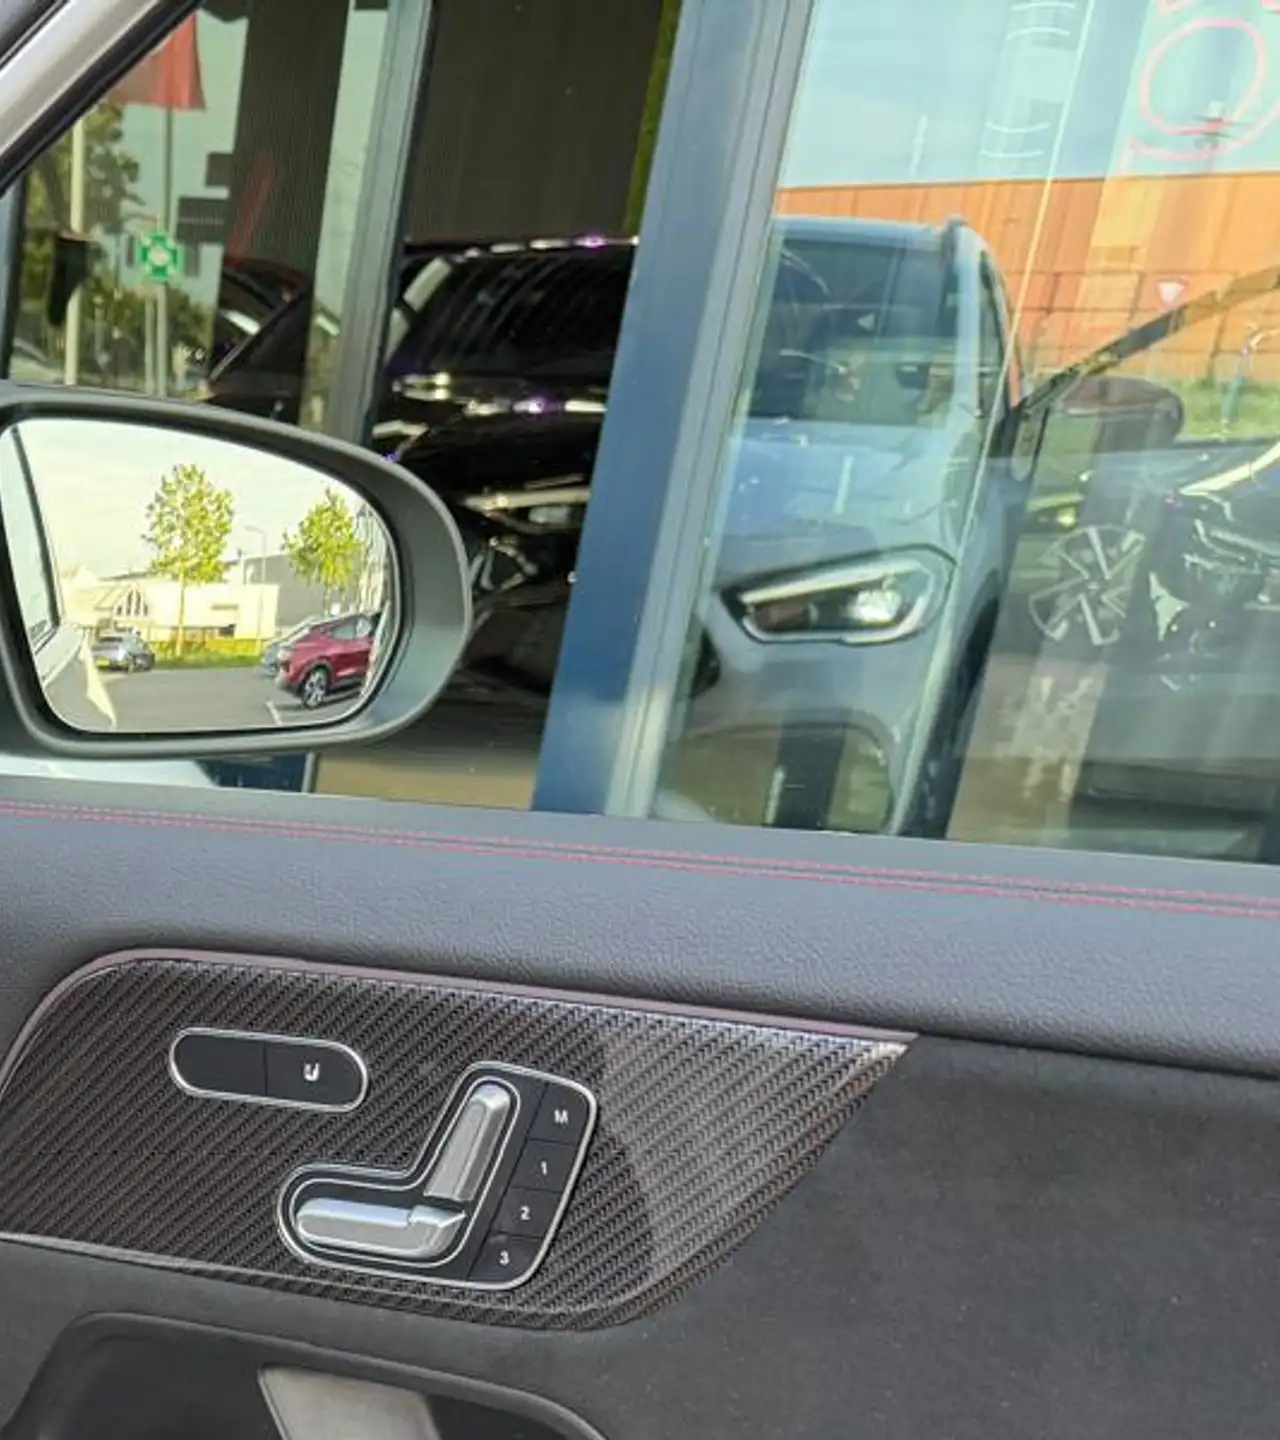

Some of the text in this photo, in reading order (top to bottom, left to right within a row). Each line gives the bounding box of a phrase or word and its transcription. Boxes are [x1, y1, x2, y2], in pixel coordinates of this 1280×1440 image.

[554, 1109, 569, 1124] M
[540, 1160, 548, 1176] 1
[519, 1205, 531, 1221] 2
[499, 1250, 509, 1266] 3
